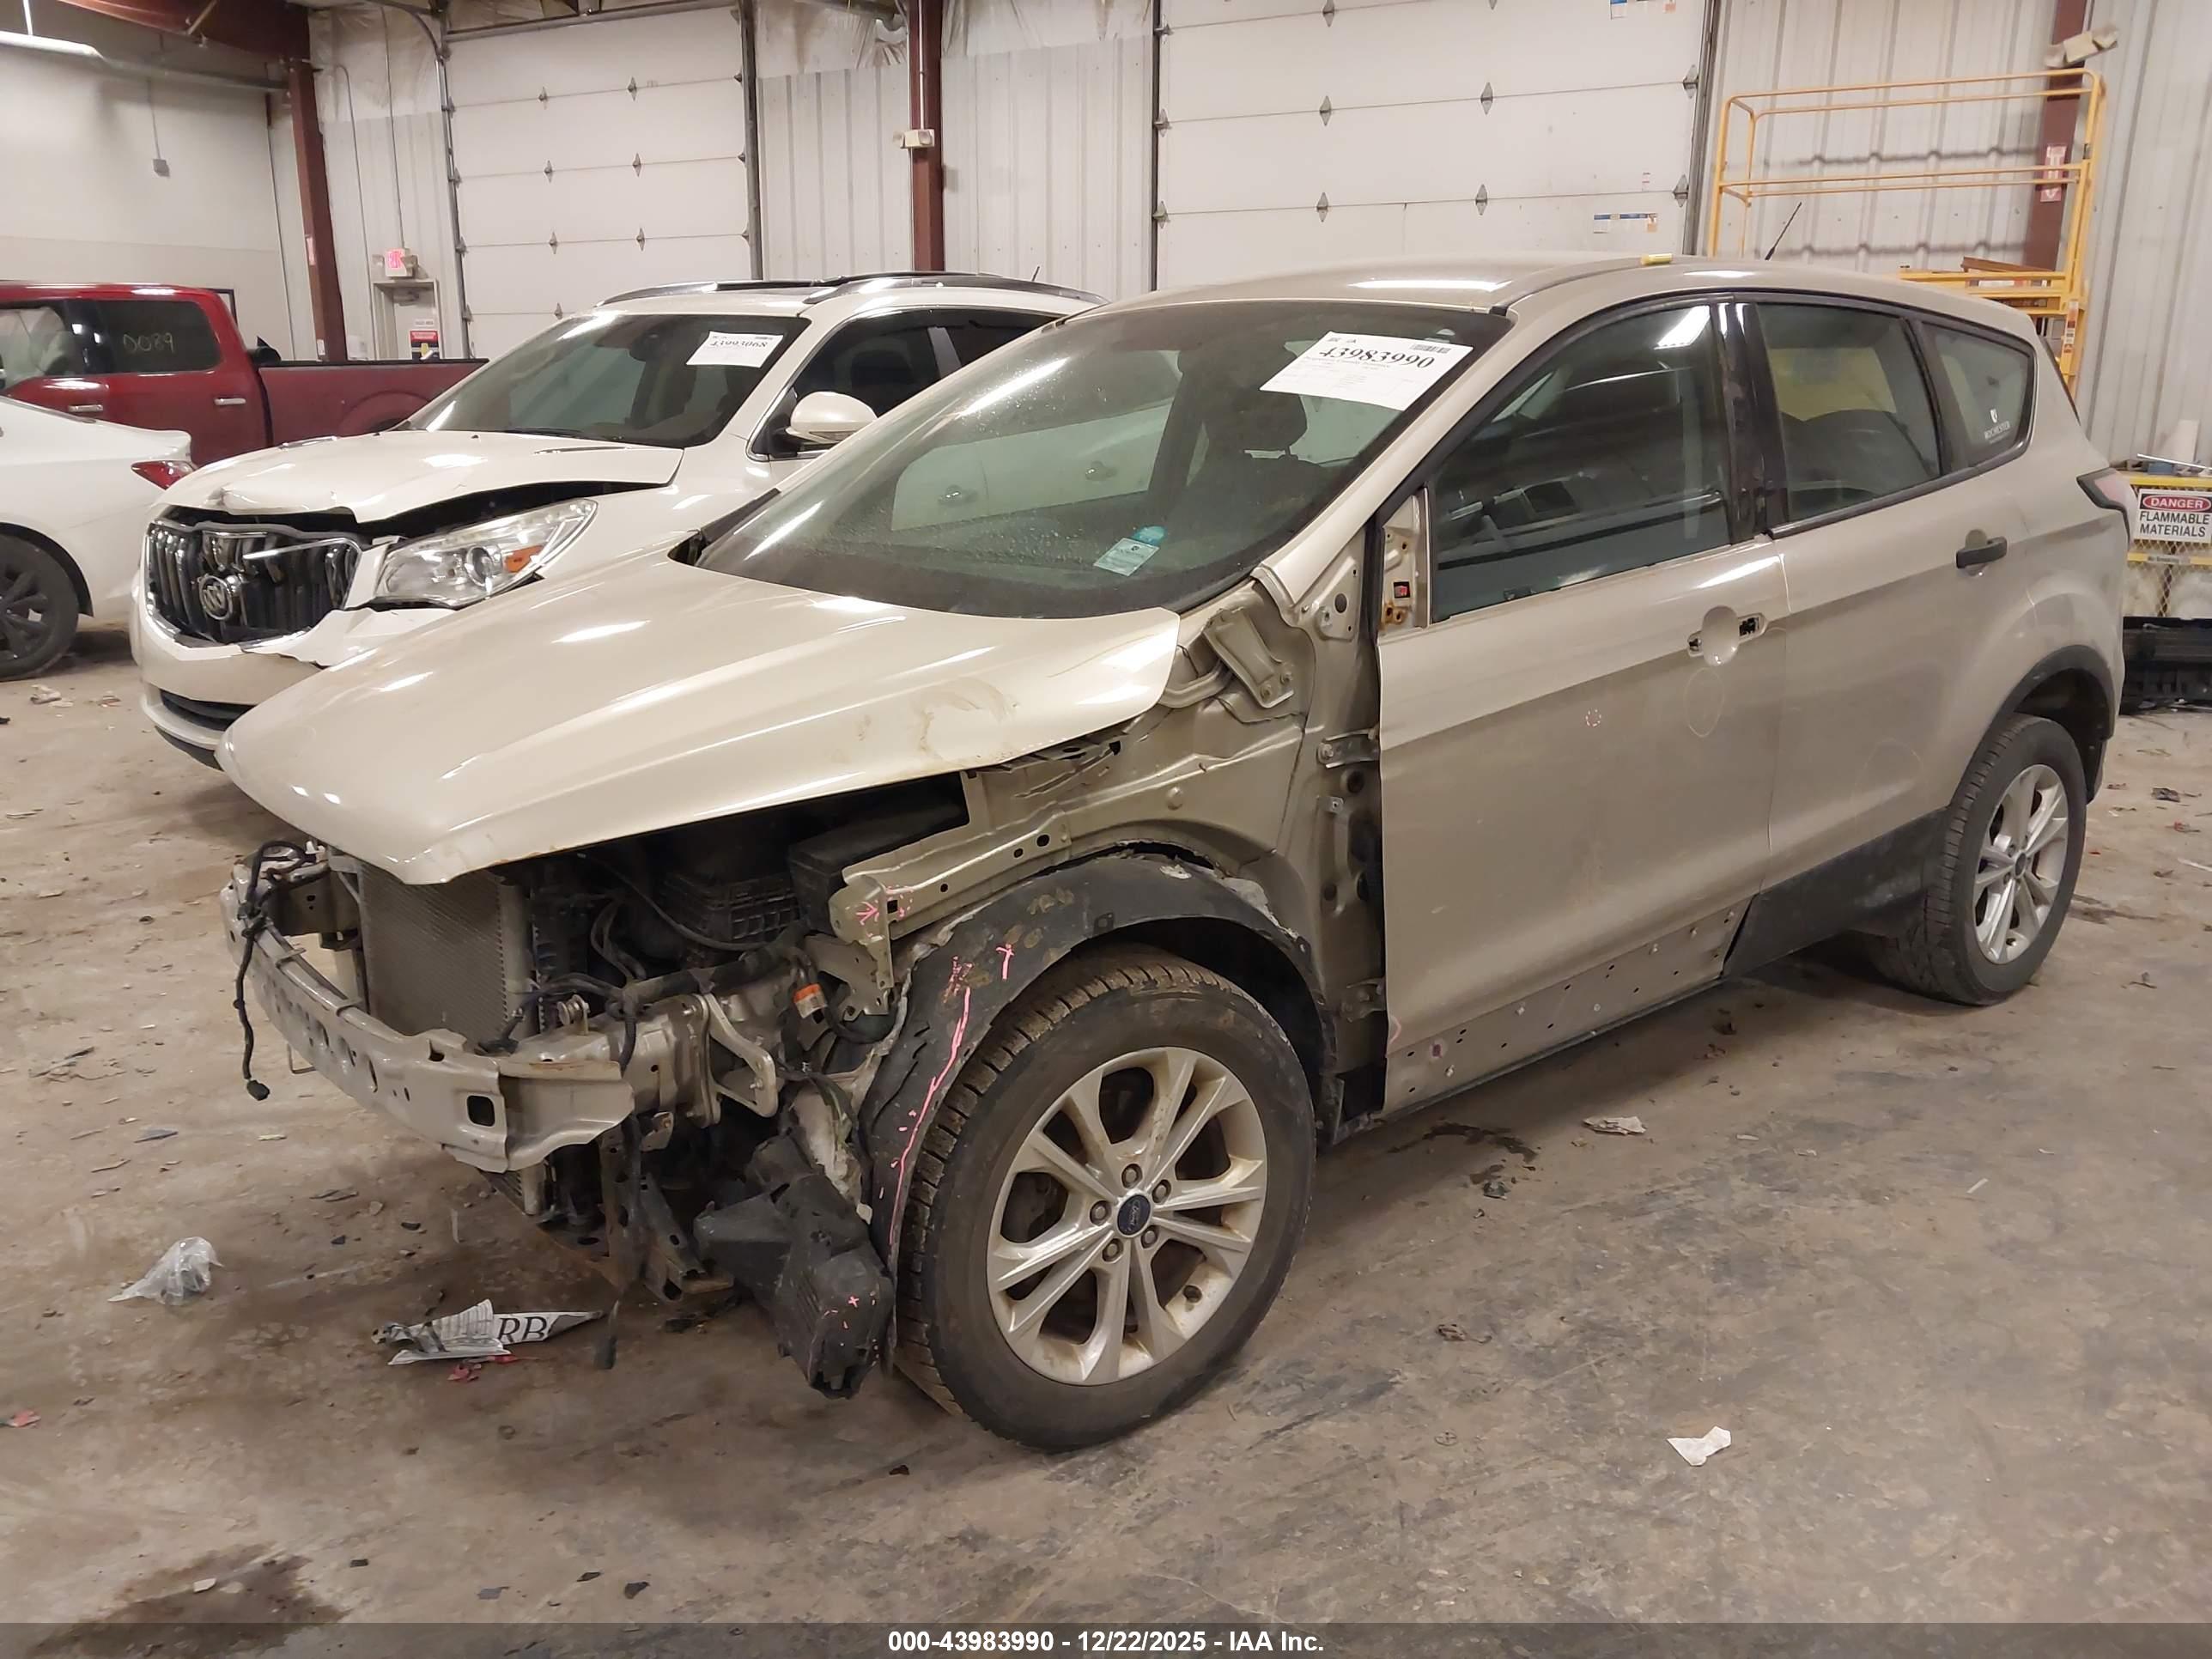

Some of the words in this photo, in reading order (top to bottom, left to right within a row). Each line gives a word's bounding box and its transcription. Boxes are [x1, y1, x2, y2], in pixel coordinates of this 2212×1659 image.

[1319, 347, 1436, 368] 43983990
[2150, 497, 2204, 509] DANGER
[2139, 510, 2211, 525] FLAMMABLE
[2139, 523, 2206, 538] MATERIALS
